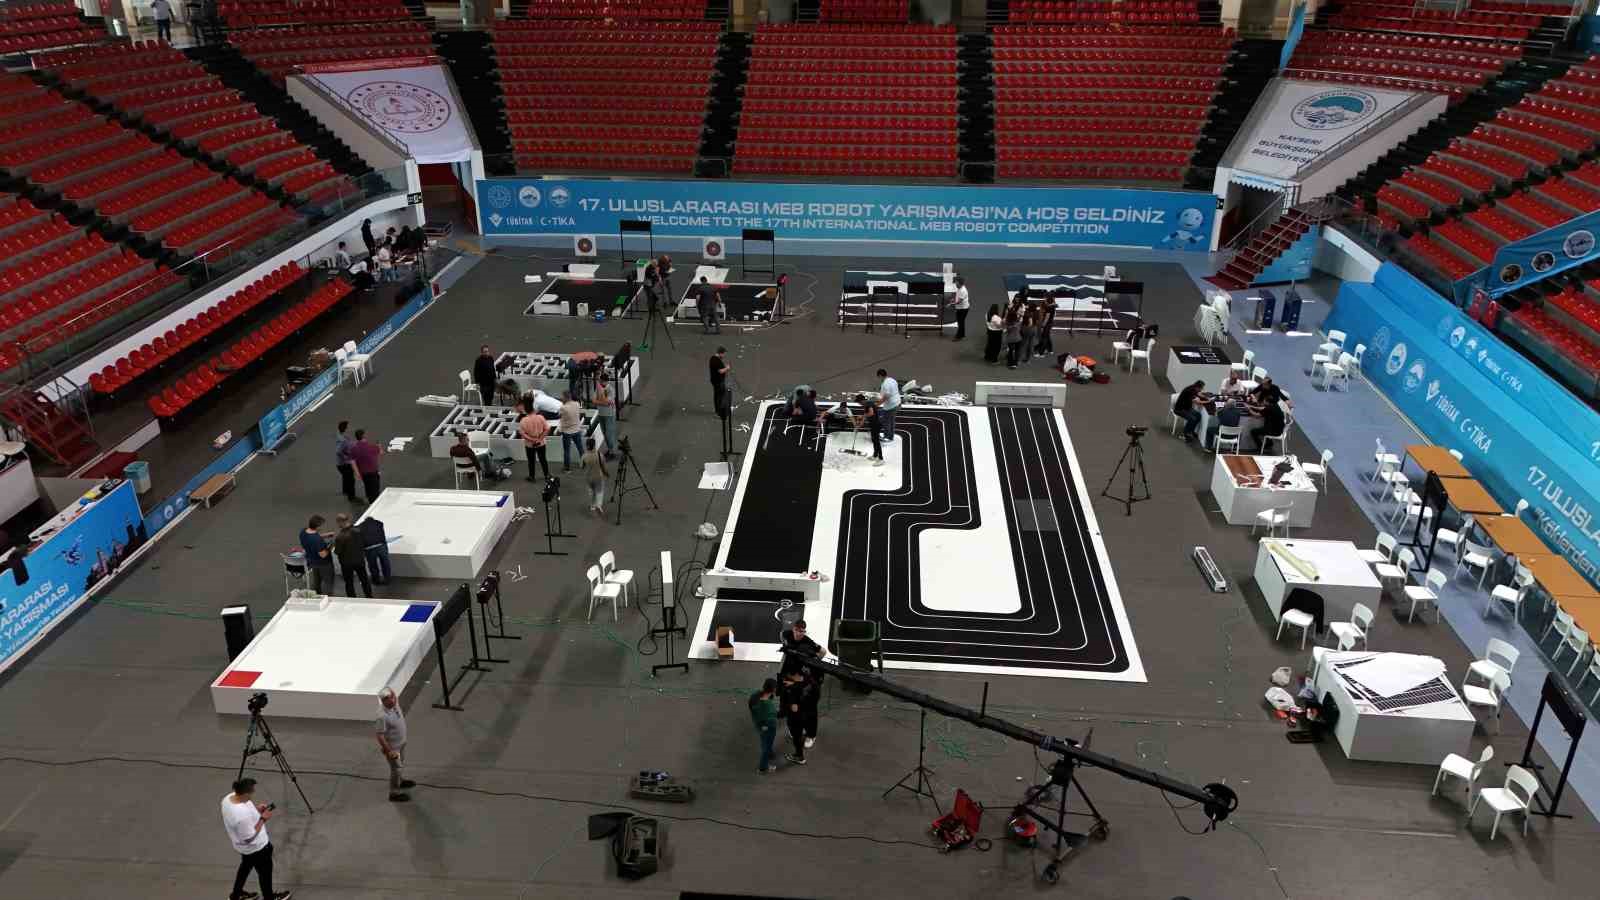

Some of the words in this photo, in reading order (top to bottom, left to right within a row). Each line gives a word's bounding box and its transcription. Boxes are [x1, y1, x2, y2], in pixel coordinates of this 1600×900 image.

[578, 198, 605, 211] 17.
[608, 198, 759, 214] ULUSLARARASI
[762, 202, 802, 215] MEB
[808, 203, 875, 217] ROBOT
[879, 204, 1022, 221] YARIŞMASI'NA
[1027, 207, 1069, 223] HOŞ
[1073, 206, 1165, 224] GELDİNİZ
[637, 215, 710, 226] WELCOME
[713, 217, 731, 226] TO
[734, 217, 762, 227] THE
[766, 218, 799, 229] 17TH
[803, 219, 918, 231] INTERNATIONAL
[920, 221, 951, 231] MEB
[954, 222, 1006, 232] ROBOT
[1008, 223, 1109, 234] COMPETITION
[1527, 465, 1547, 492] 17.
